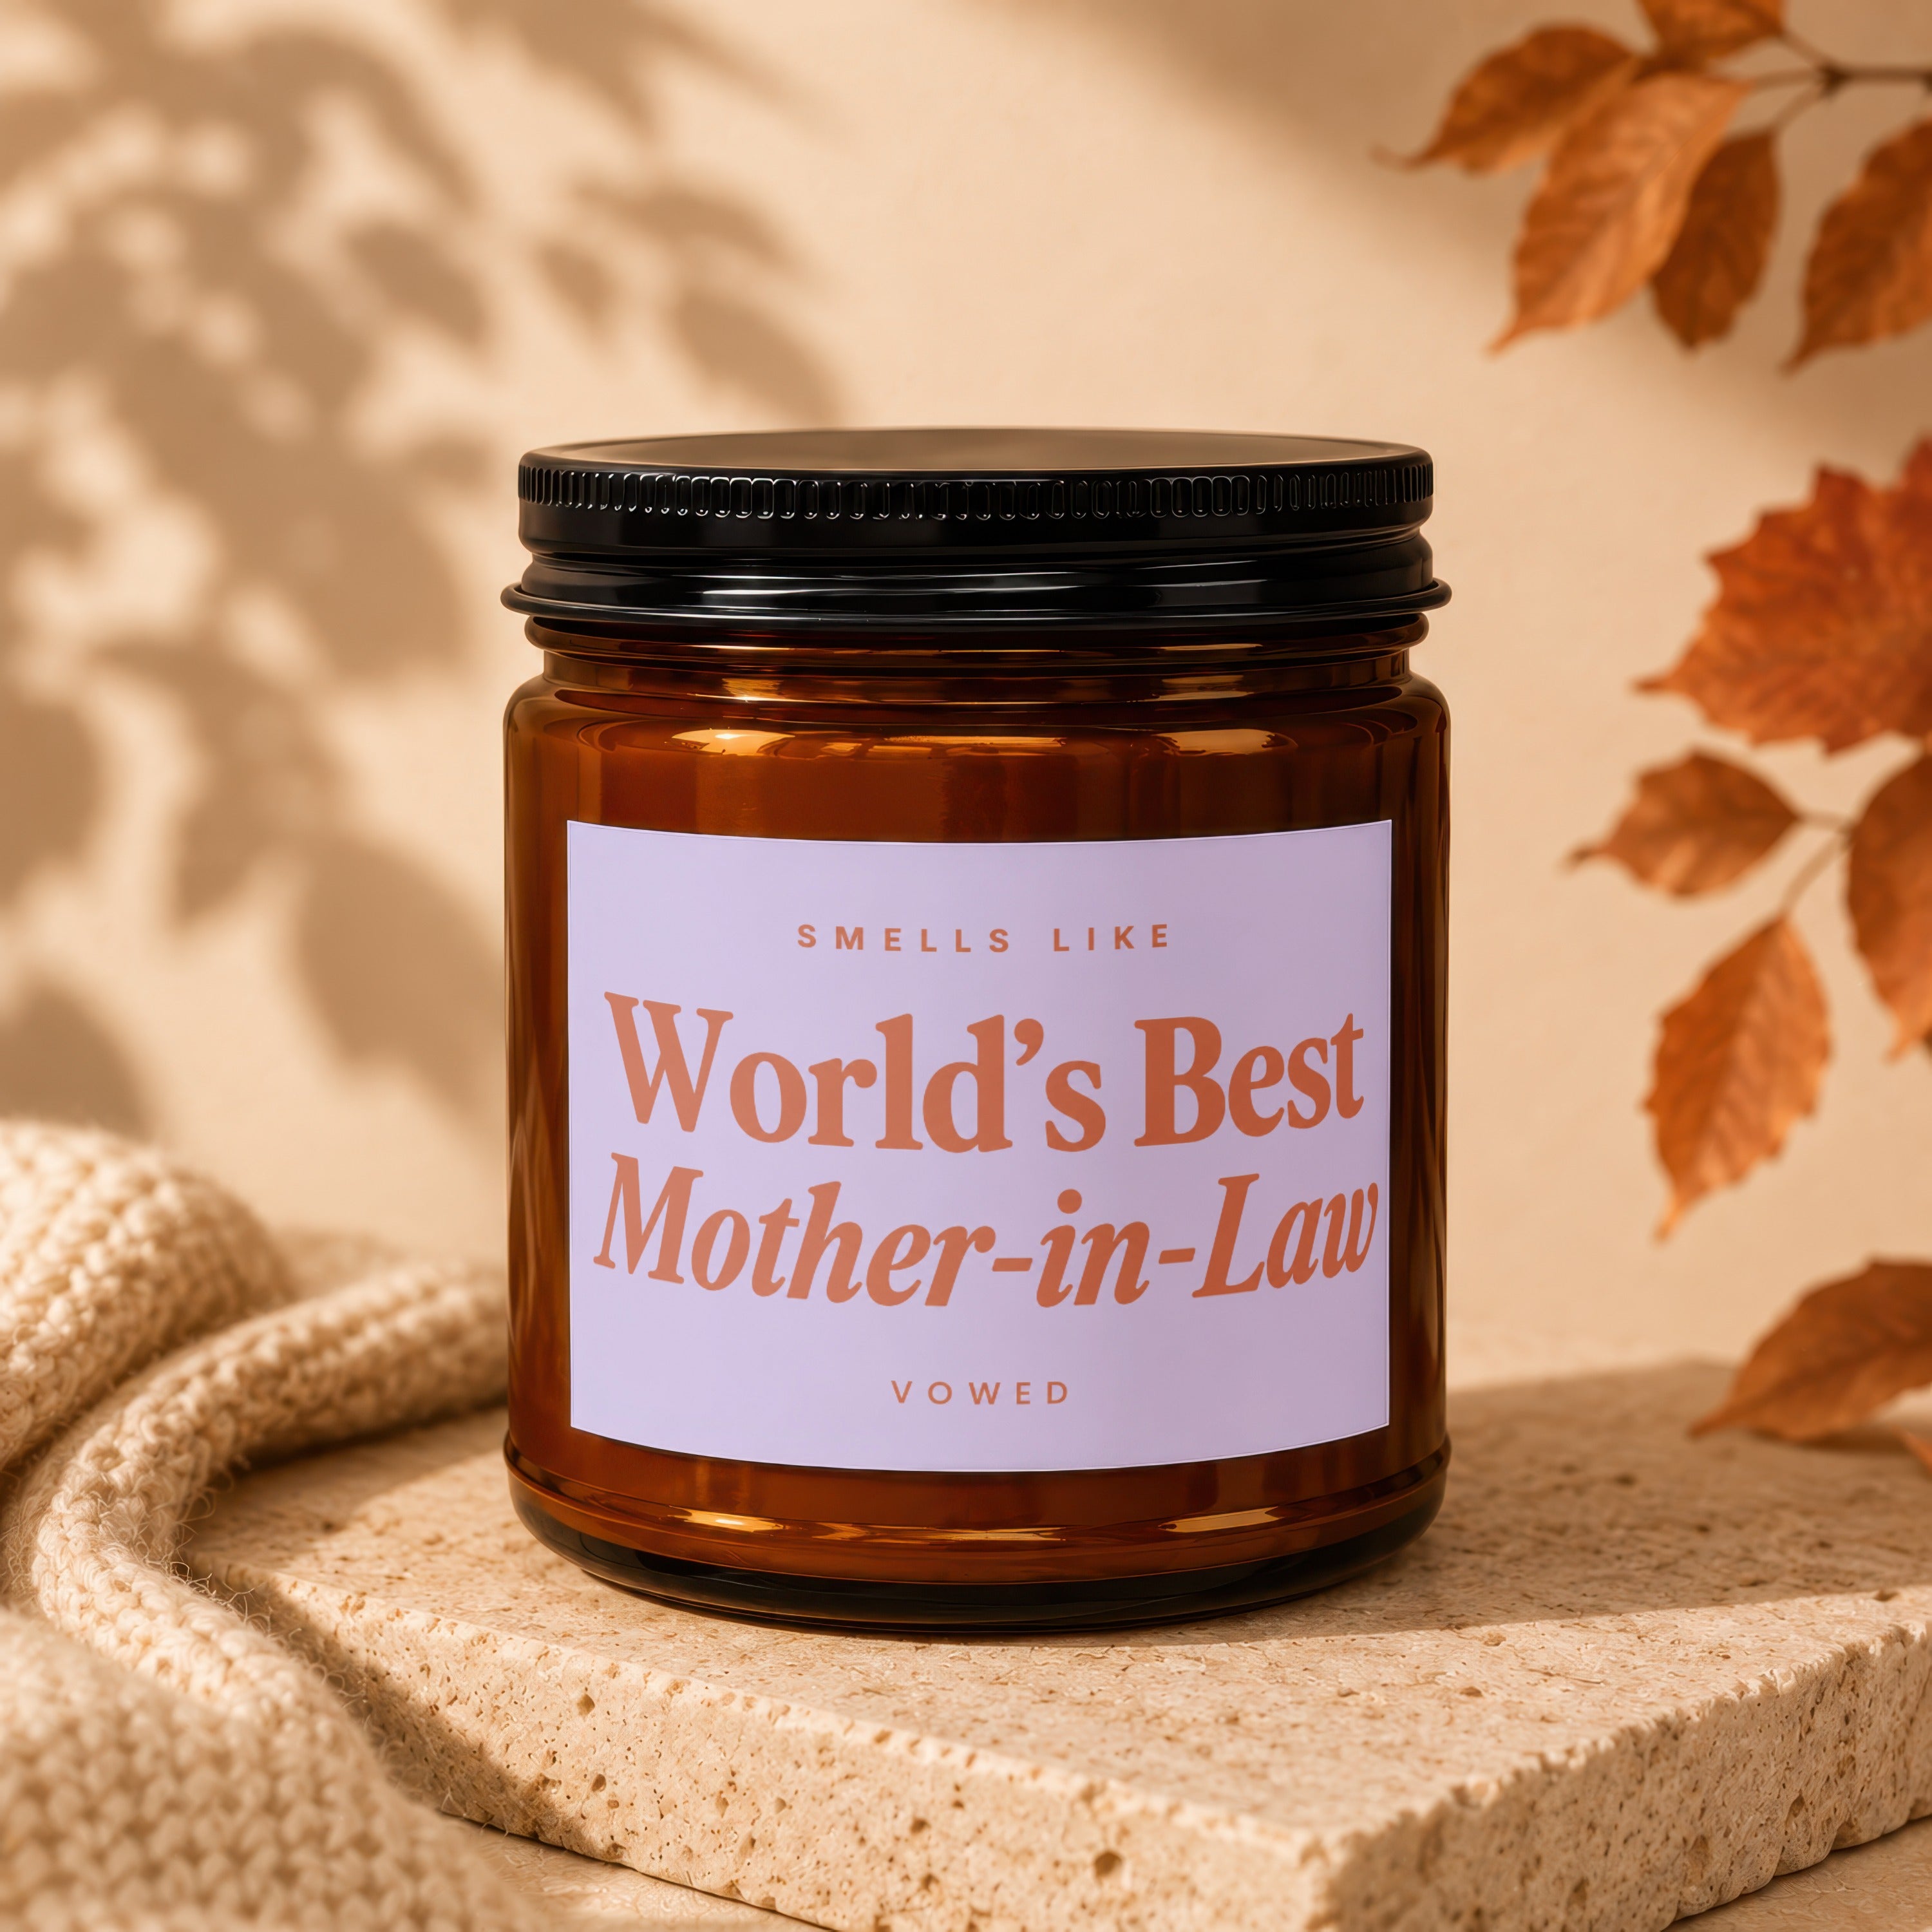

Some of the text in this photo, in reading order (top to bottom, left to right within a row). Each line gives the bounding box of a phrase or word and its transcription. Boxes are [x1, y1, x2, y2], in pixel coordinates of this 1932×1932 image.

[797, 922, 1169, 954] SMELLS LIKE
[603, 990, 1365, 1155] World’s Best
[592, 1151, 1380, 1309] Mother-in-Law
[890, 1379, 1069, 1406] VOWED
